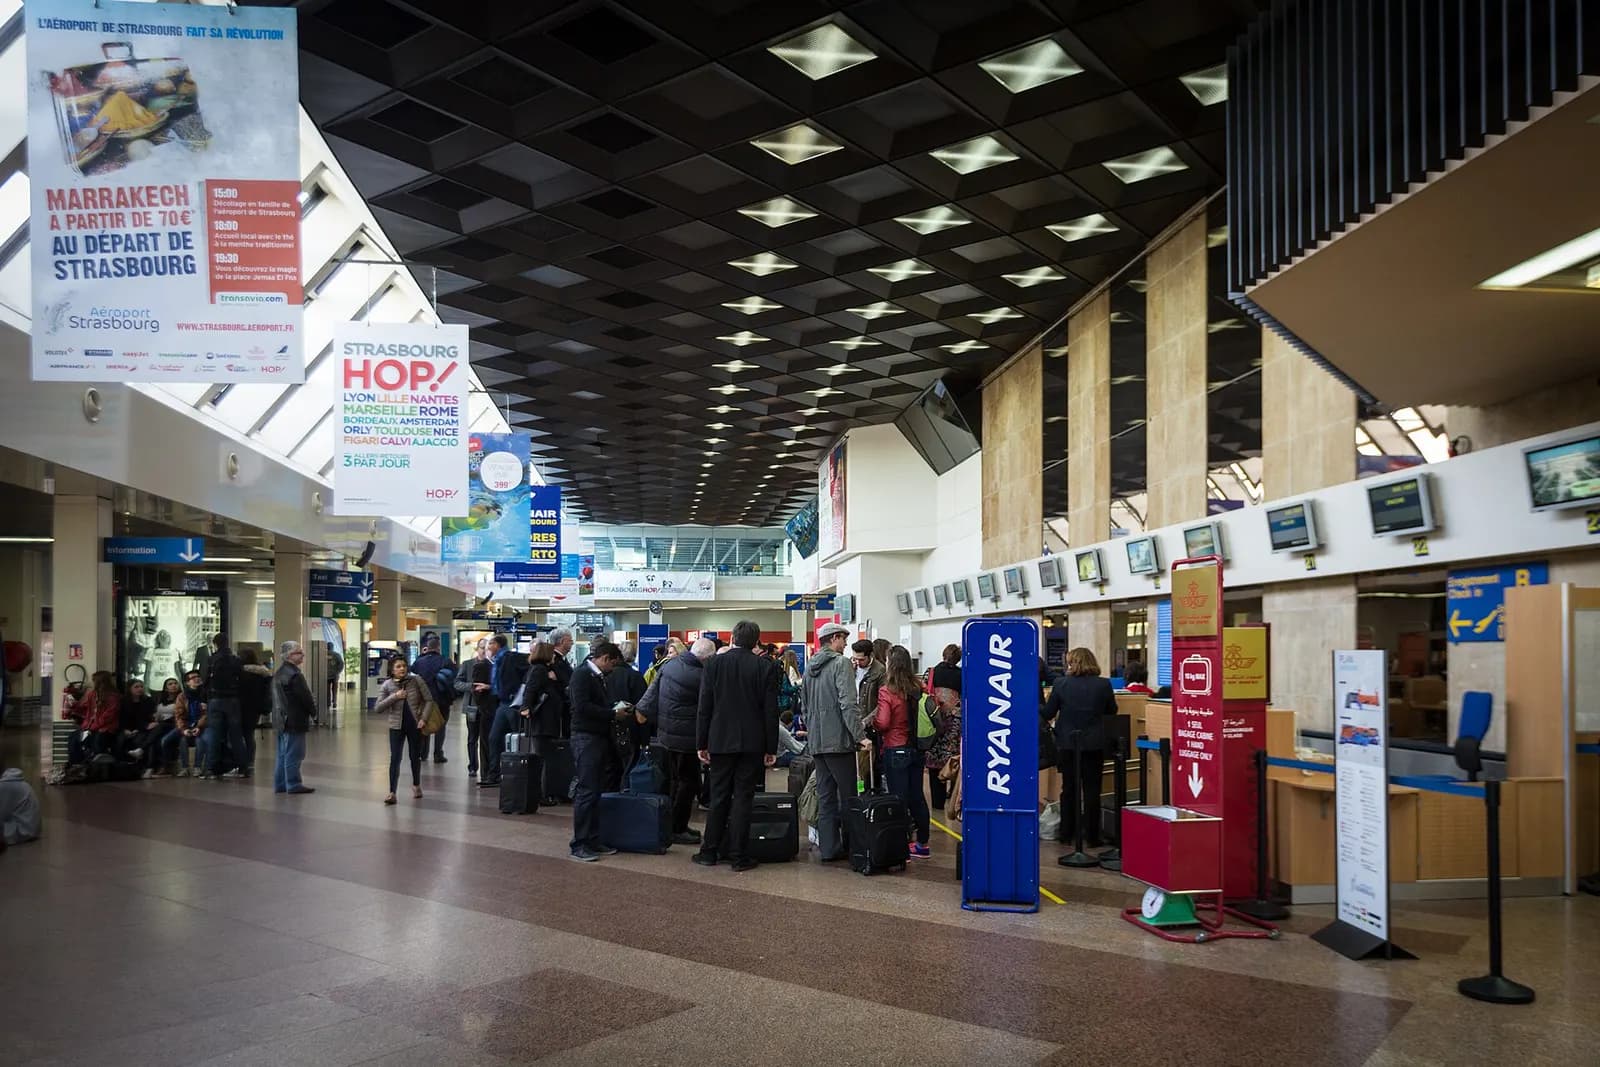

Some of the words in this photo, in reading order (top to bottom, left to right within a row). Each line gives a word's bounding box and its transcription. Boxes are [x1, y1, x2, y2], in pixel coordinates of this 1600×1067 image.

[103, 22, 116, 33] DE
[118, 22, 182, 36] STRASBOURG
[186, 26, 206, 38] FAIT
[209, 28, 223, 38] SA
[226, 26, 284, 40] RÉVOLUTION
[46, 184, 190, 211] MARRAKECH
[214, 188, 238, 198] 15:00
[259, 209, 296, 218] Strasbourg
[66, 212, 125, 230] PARTIR
[130, 211, 153, 228] DE
[214, 220, 238, 231] 18:00
[53, 235, 78, 256] AU
[85, 230, 161, 254] DÉPART
[167, 231, 194, 250] DE
[215, 253, 239, 263] 19:30
[54, 254, 196, 280] STRASBOURG
[90, 306, 150, 320] Aéroport
[69, 316, 160, 333] Strasbourg
[177, 323, 294, 332] WWW.STRASBOURG.AEROPORT.FR
[344, 342, 458, 358] STRASBOURG
[344, 358, 458, 392] HOP!
[344, 393, 376, 402] LYON
[377, 394, 408, 403] LILLE
[410, 395, 458, 405] NANTES
[344, 405, 417, 415] MARSEILLE
[420, 406, 458, 416] ROME
[344, 416, 398, 425] BORDEAUX
[400, 418, 458, 426] AMSTERDAM
[344, 426, 372, 434] ORLY
[374, 426, 432, 436] TOULOUSE
[434, 428, 458, 437] NICE
[344, 436, 379, 445] FIGARI
[380, 437, 411, 446] CALVI
[412, 438, 458, 447] AJACCIO
[344, 455, 352, 467] 3
[354, 459, 376, 468] PAR
[379, 459, 410, 468] JOUR
[426, 489, 458, 499] HOP!
[107, 546, 157, 555] Information
[1412, 539, 1429, 554] 22
[128, 600, 177, 617] NEVER
[987, 633, 1012, 794] RYANAIR
